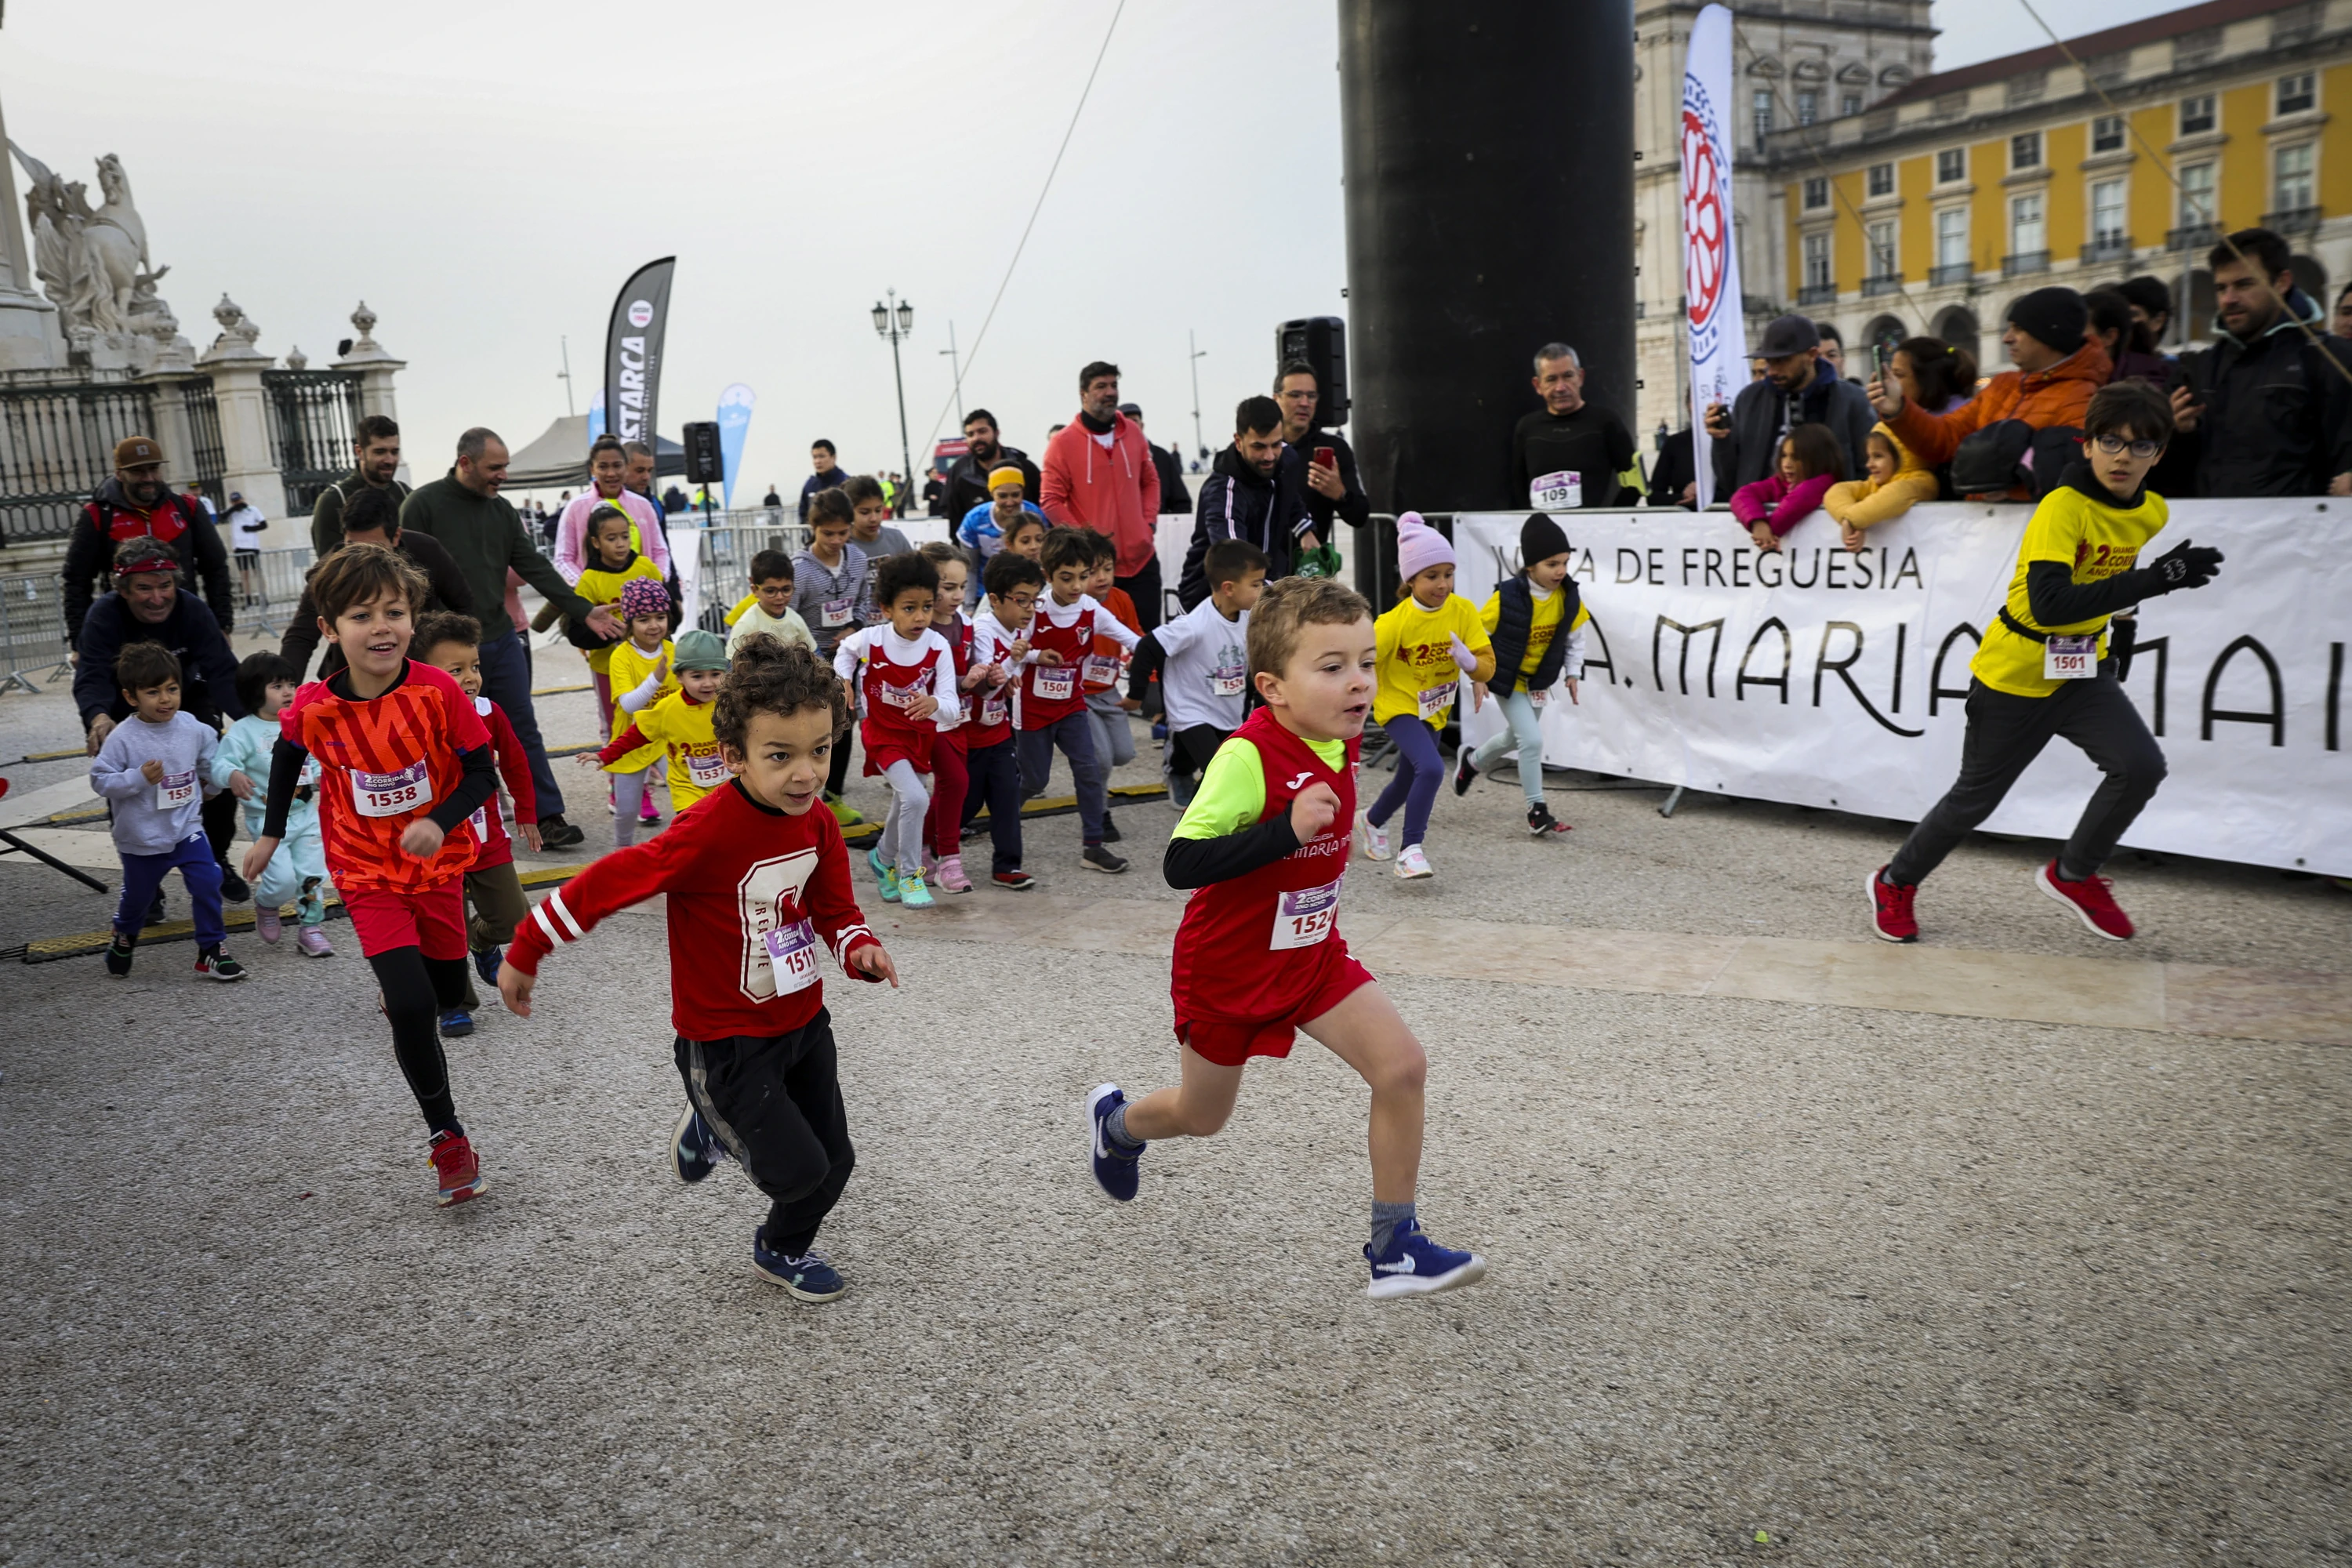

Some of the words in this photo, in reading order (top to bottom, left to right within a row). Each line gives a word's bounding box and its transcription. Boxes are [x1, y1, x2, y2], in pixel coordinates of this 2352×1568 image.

[1541, 488, 1567, 502] 109
[1615, 547, 1665, 586] DE
[1683, 548, 1924, 590] FREGUESIA
[2053, 655, 2085, 669] 1501
[372, 775, 405, 784] CORRIDA
[366, 786, 417, 807] 1538
[1294, 840, 1339, 858] MARIA
[785, 946, 816, 975] 1511
